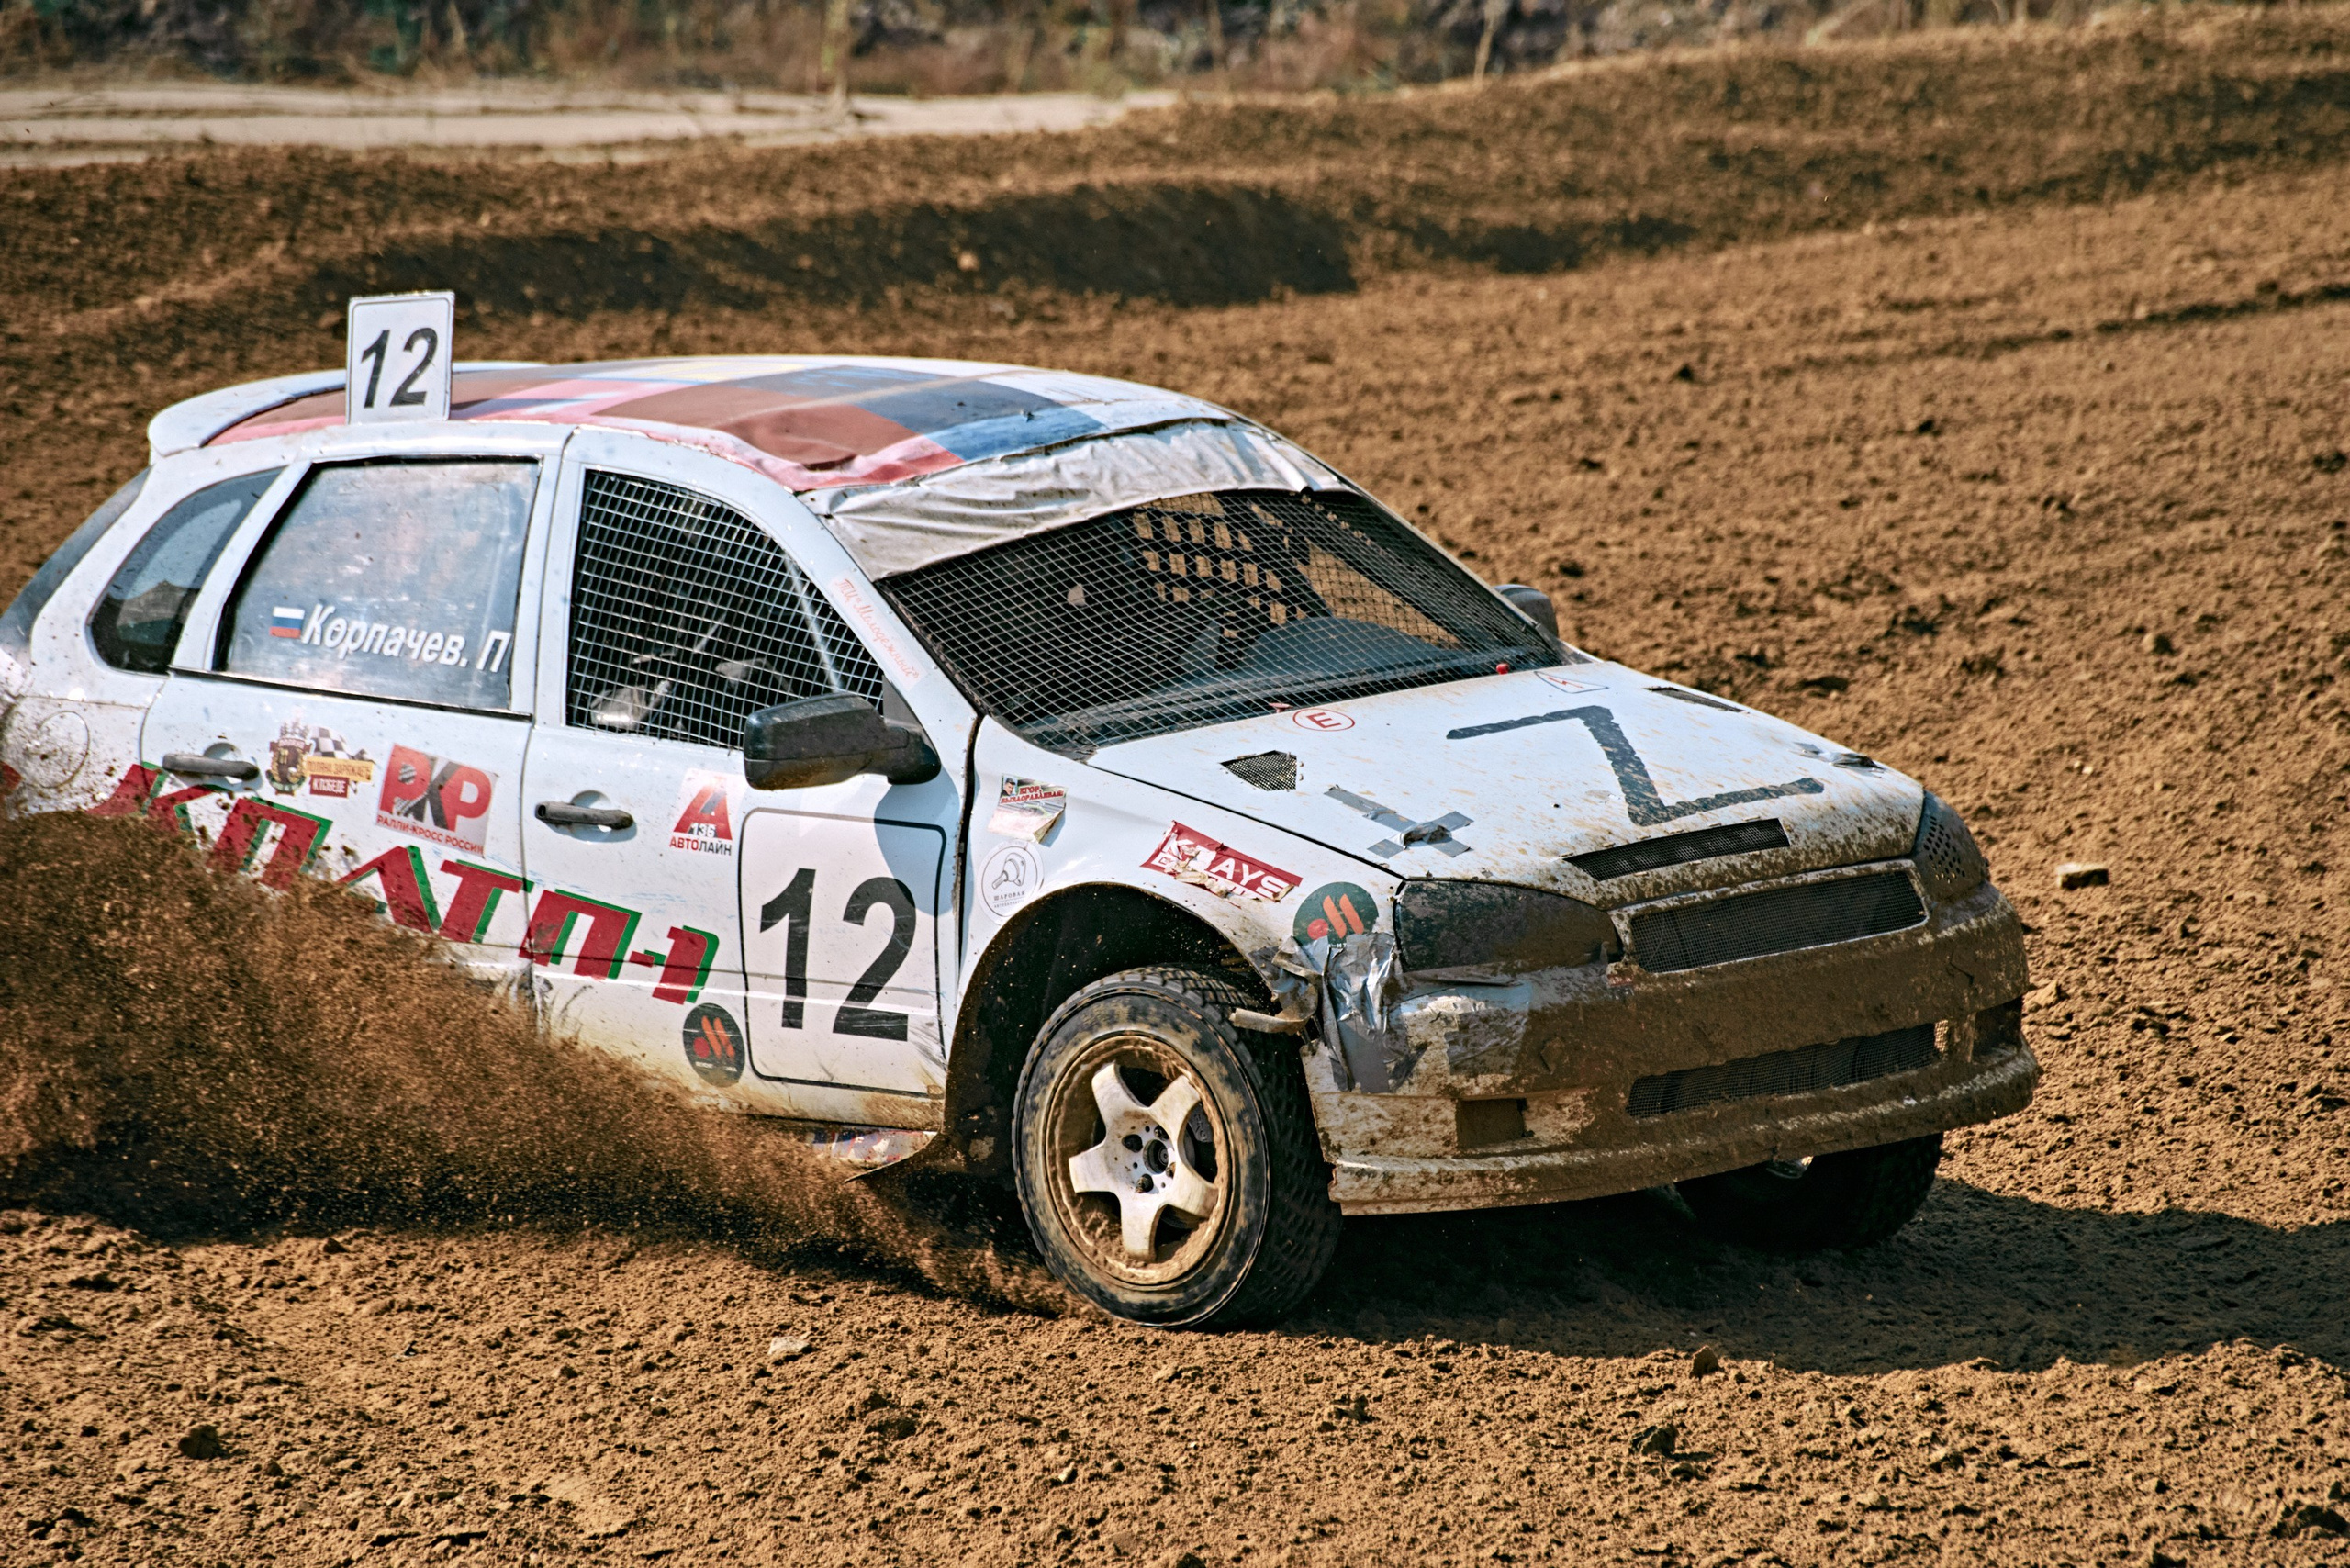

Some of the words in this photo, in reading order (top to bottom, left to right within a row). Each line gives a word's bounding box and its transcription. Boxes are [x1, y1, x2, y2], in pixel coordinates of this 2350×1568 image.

[359, 326, 440, 409] 12
[300, 603, 470, 668] Корпачев.
[476, 629, 512, 674] П
[377, 814, 443, 844] РАЛЛИ-КРОСС
[444, 835, 484, 855] РОССИИ
[669, 836, 733, 857] АВТОЛАЙН
[690, 823, 717, 838] 136
[1161, 831, 1291, 900] KAYS
[993, 890, 1024, 901] ШАРОВАЯ
[758, 867, 918, 1043] 12
